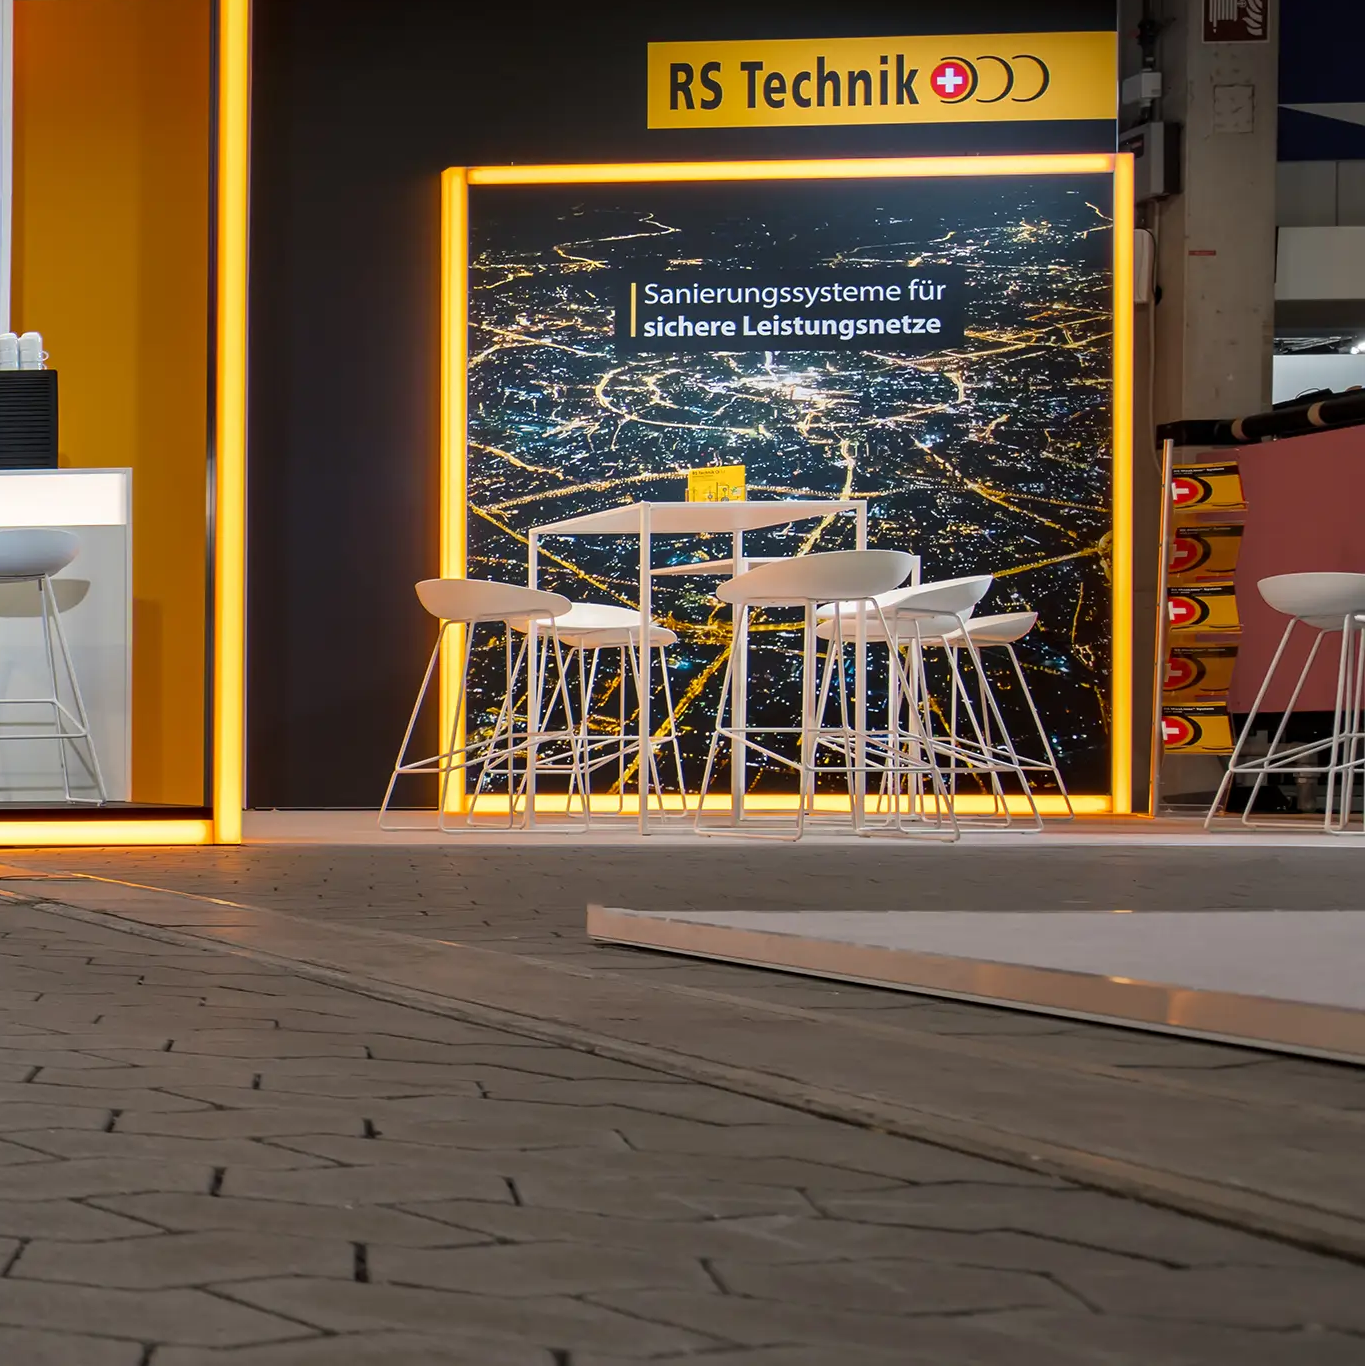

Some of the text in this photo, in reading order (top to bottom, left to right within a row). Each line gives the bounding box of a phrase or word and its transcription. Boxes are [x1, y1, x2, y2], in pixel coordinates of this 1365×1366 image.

[669, 55, 919, 110] RS Technik
[644, 279, 947, 309] Sanierungssysteme für
[643, 314, 942, 341] sichere Leistungsnetze
